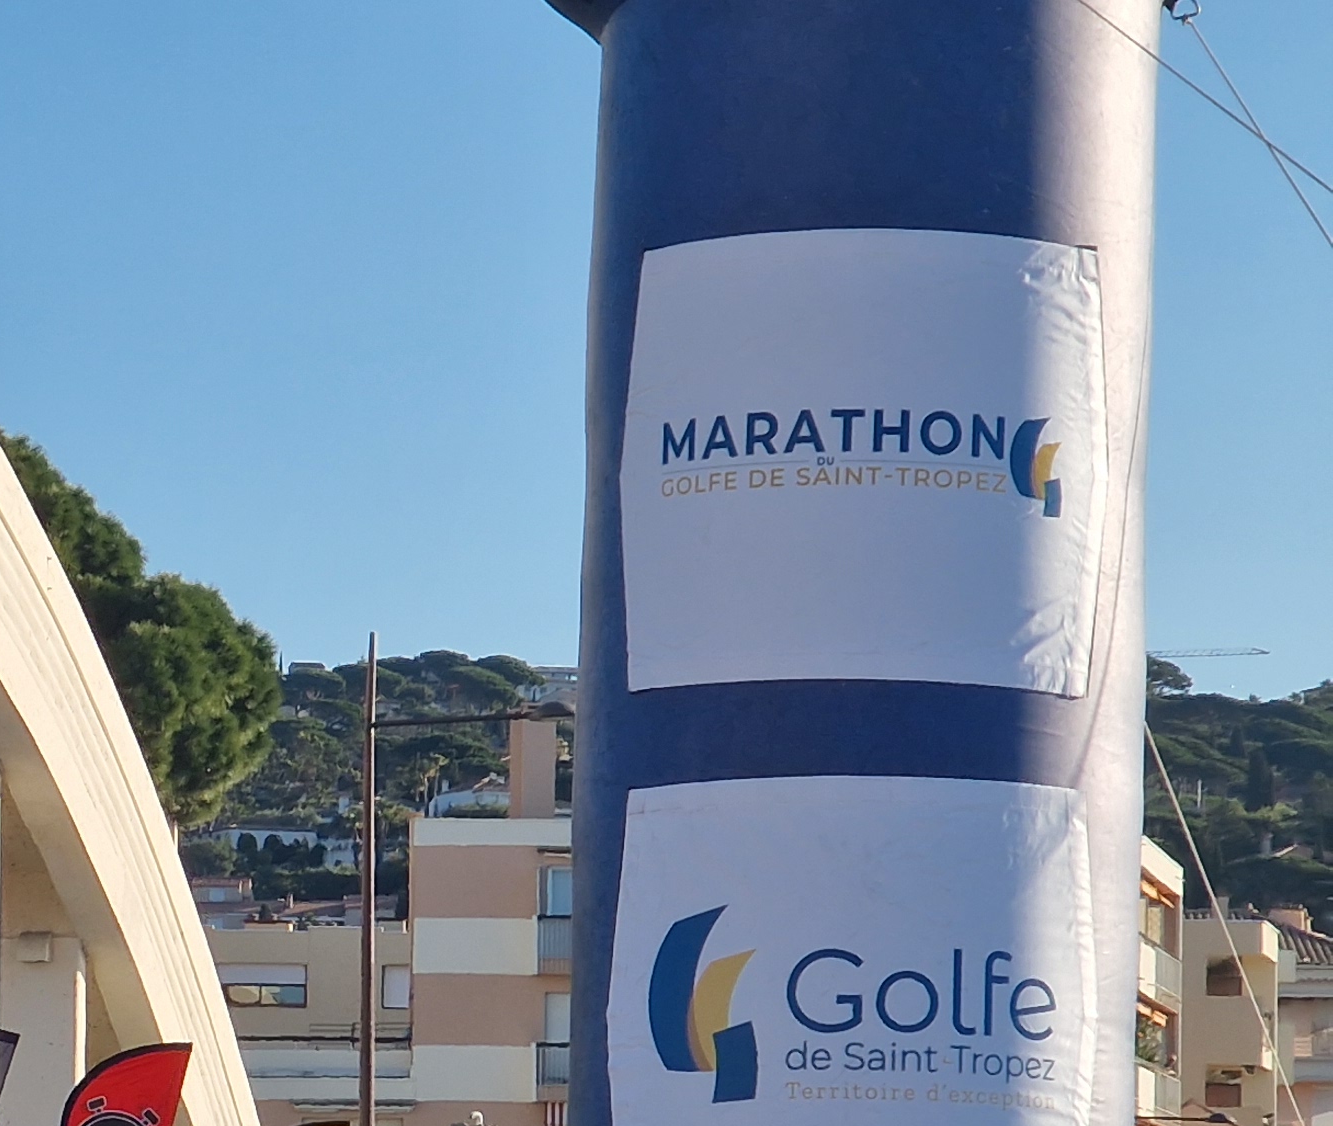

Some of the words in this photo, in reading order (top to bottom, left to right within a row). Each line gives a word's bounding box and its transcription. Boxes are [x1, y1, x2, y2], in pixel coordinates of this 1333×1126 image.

[661, 408, 1006, 466] MARATHON
[816, 455, 835, 467] DU
[661, 471, 737, 498] GOLFE
[748, 468, 786, 489] DE
[795, 465, 1007, 494] SAINT-TROPEZ
[786, 948, 1057, 1041] Golfe
[785, 1040, 832, 1071] de
[785, 1081, 915, 1101] Territoire
[926, 1084, 1055, 1111] d'exception
